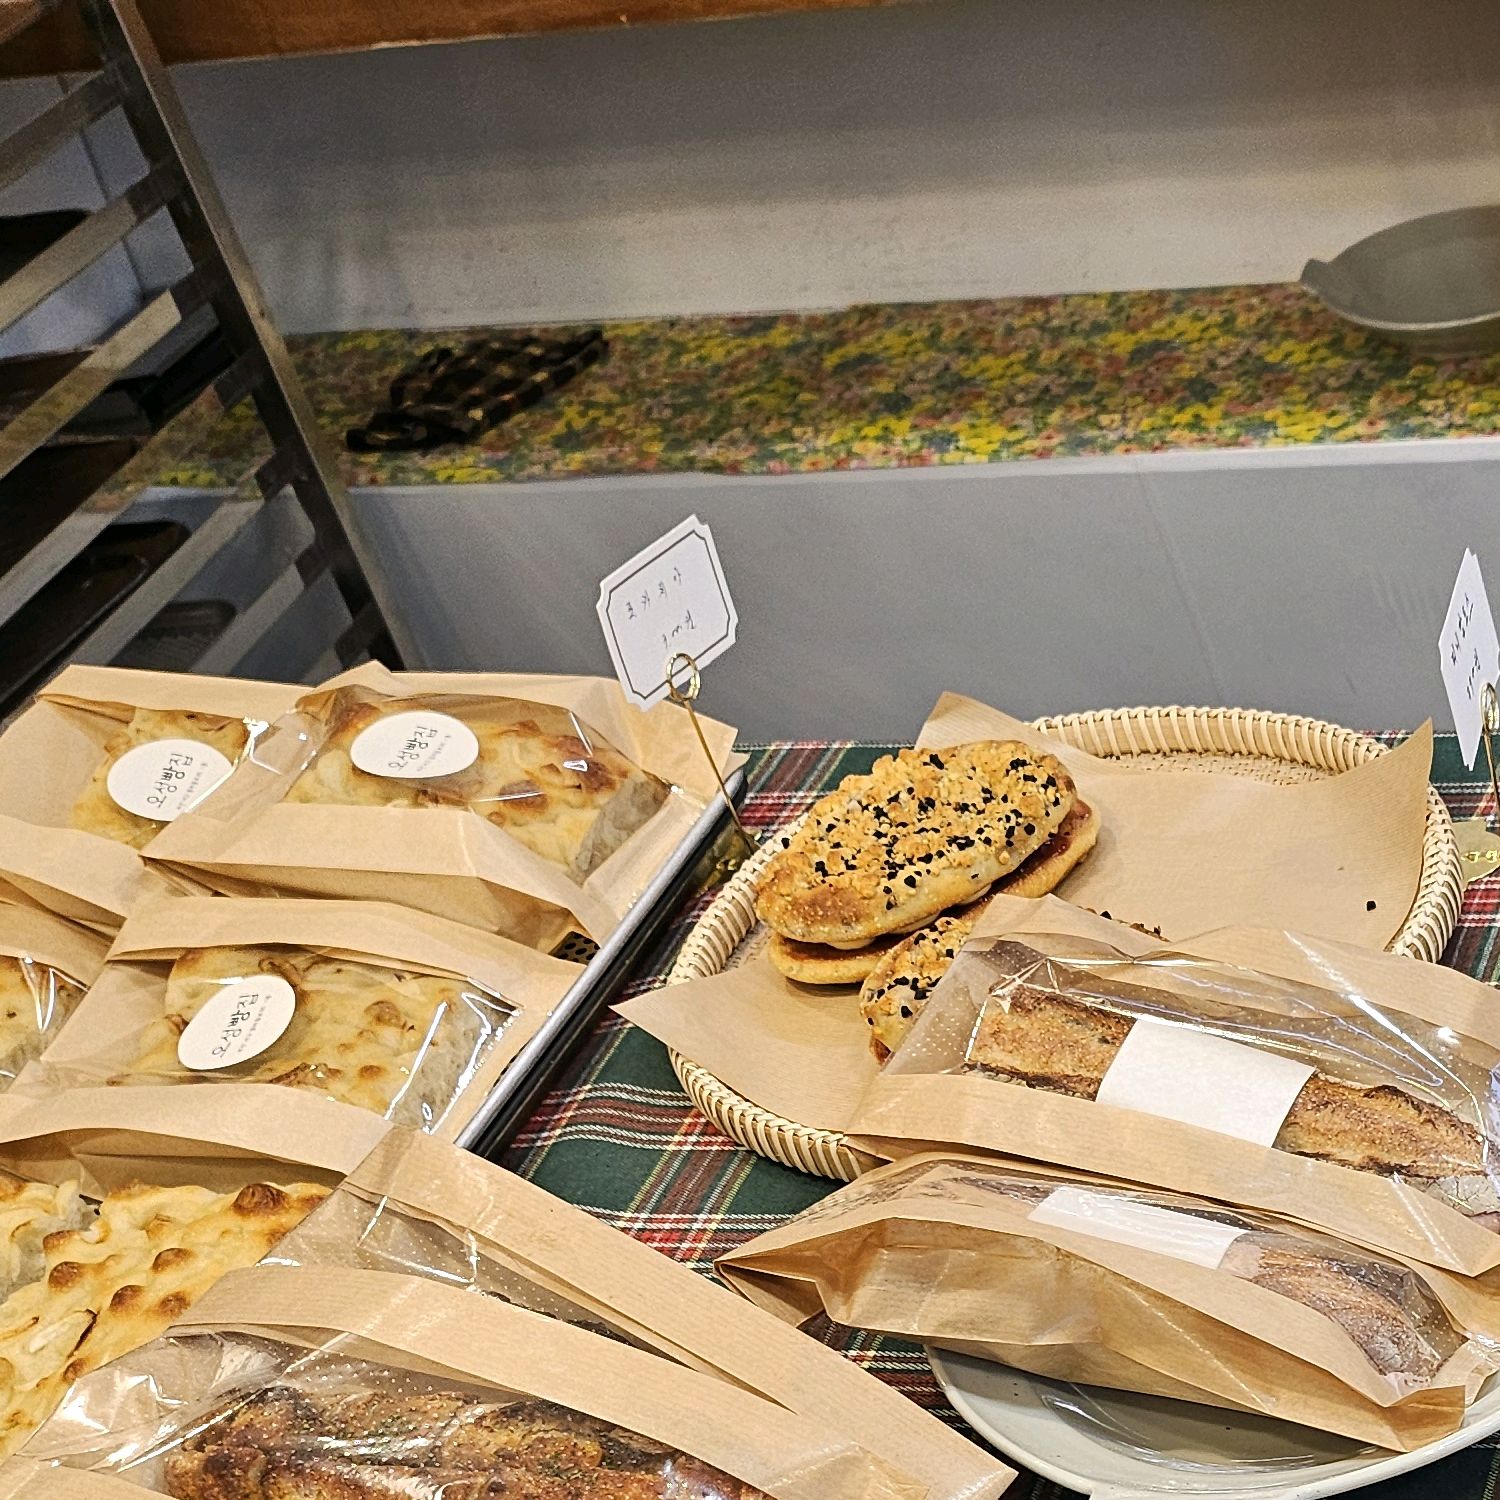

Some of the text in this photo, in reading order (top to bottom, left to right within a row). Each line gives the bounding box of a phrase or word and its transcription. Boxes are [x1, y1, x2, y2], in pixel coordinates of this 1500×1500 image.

[388, 724, 438, 771] 오성빵집
[146, 752, 194, 809] 오성빵집
[212, 993, 259, 1058] 오성빵집
